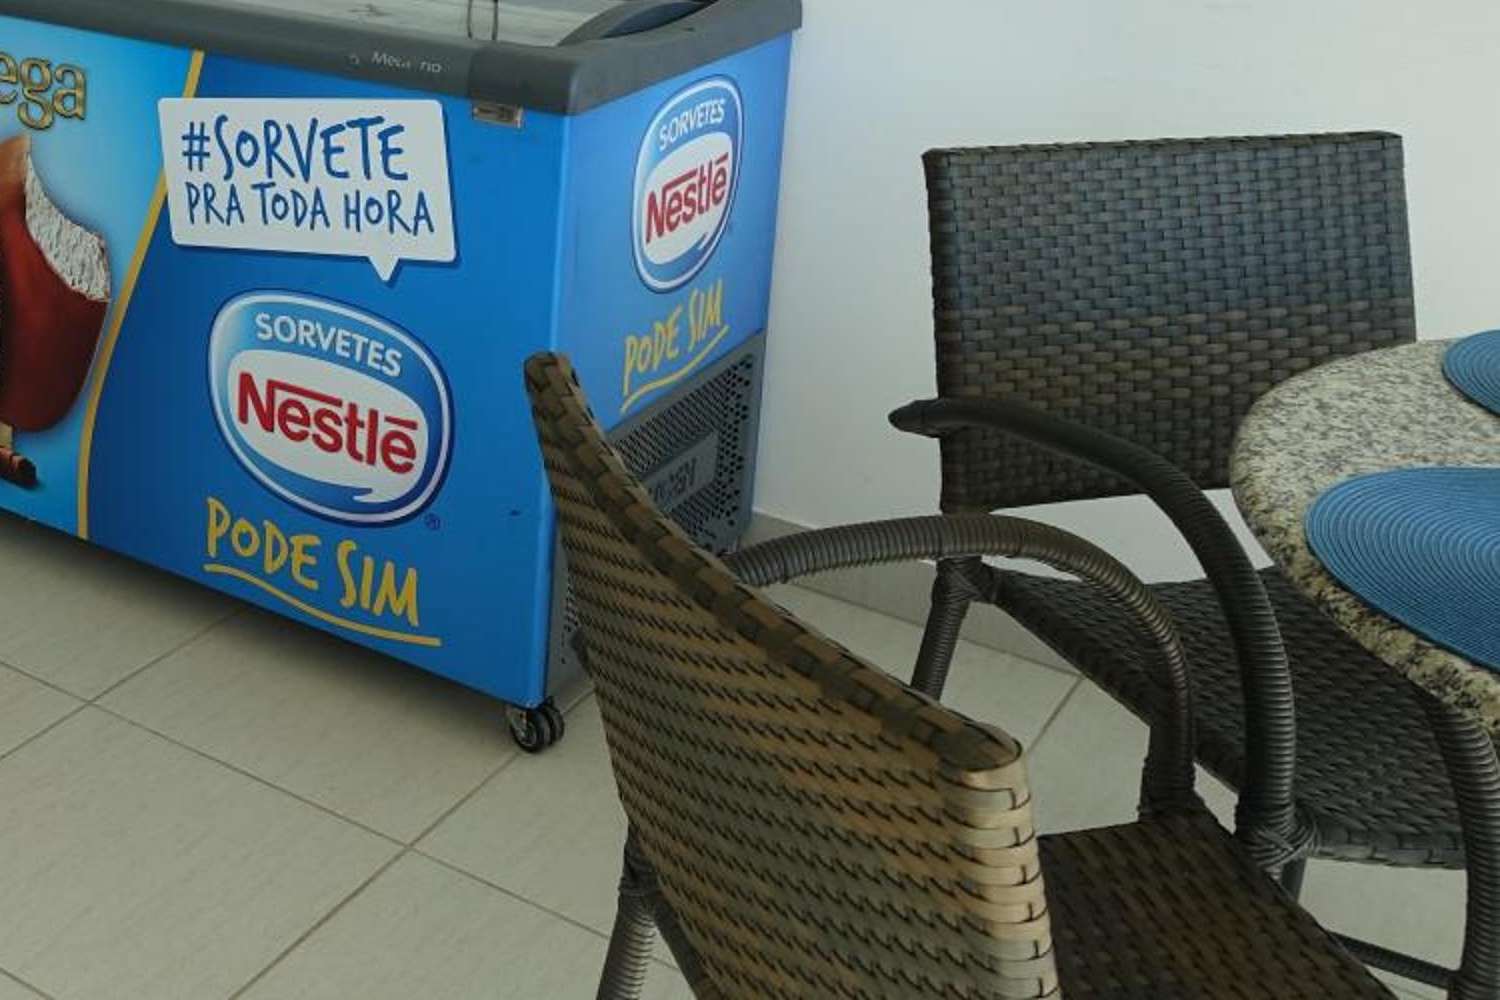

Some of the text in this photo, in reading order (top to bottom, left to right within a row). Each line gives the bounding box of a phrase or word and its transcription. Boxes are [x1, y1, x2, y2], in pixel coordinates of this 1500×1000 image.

[182, 114, 409, 183] #SORVETE
[658, 99, 725, 151] SORVETES
[186, 181, 435, 236] PRA TODA HORA
[645, 152, 729, 244] Nestlé
[255, 312, 403, 377] SORVETES
[622, 279, 724, 397] PODE SIM
[238, 371, 419, 474] Nestlé
[206, 497, 419, 627] PODE SIM
